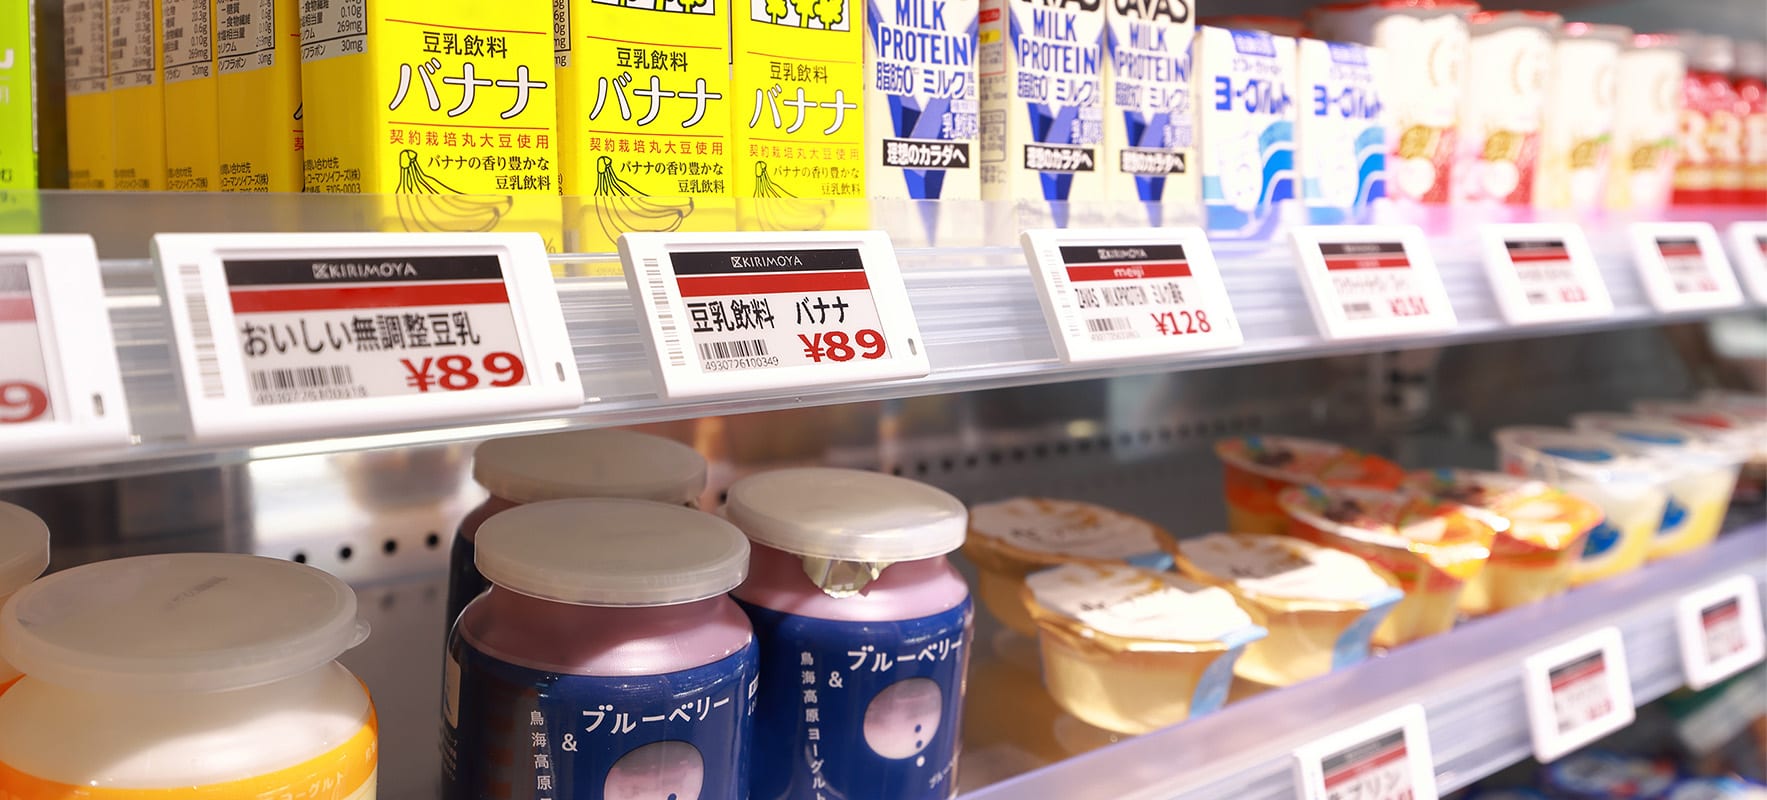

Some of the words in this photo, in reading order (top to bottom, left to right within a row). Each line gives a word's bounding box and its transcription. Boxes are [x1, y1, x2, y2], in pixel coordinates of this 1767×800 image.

[337, 20, 362, 32] 269mg
[896, 0, 945, 31] MILK
[1034, 8, 1077, 42] MILK
[341, 40, 363, 52] 30mg
[423, 31, 507, 58] 豆乳飲料
[881, 26, 968, 66] PROTEIN
[1130, 21, 1167, 52] MILK
[616, 47, 688, 72] 豆乳飲料
[1022, 38, 1096, 75] PROTEIN
[769, 61, 828, 84] 豆乳飲料
[388, 57, 547, 120] バナナ
[589, 71, 722, 128] バナナ
[749, 83, 857, 135] バナナ
[390, 129, 549, 149] 契約栽培丸大豆使用
[590, 137, 723, 156] 契約栽培丸大豆使用
[428, 155, 550, 171] バナナの香り豊かな
[749, 144, 859, 161] 契約栽培丸大豆使用
[887, 142, 967, 166] 理想のカラダへ
[620, 160, 724, 176] バナナの香り豊かな
[773, 165, 860, 180] バナナの香り豊かな
[495, 175, 551, 190] 豆乳飲料
[678, 179, 725, 194] 豆乳飲料
[821, 183, 861, 196] 豆乳飲料
[329, 263, 418, 279] KIRIMOYA
[742, 256, 803, 269] KIRIMOYA
[687, 298, 775, 333] 豆乳飲料
[795, 295, 849, 325] バナナ
[1151, 310, 1212, 336] ¥128
[240, 311, 481, 358] おいしい無調整豆乳
[797, 328, 886, 364] ¥89
[399, 351, 525, 392] ¥89
[848, 638, 963, 673] ブルーベリー
[828, 671, 843, 688] &
[582, 696, 730, 734] ブルーベリー
[530, 710, 553, 800] 鳥海高原
[561, 733, 578, 752] &
